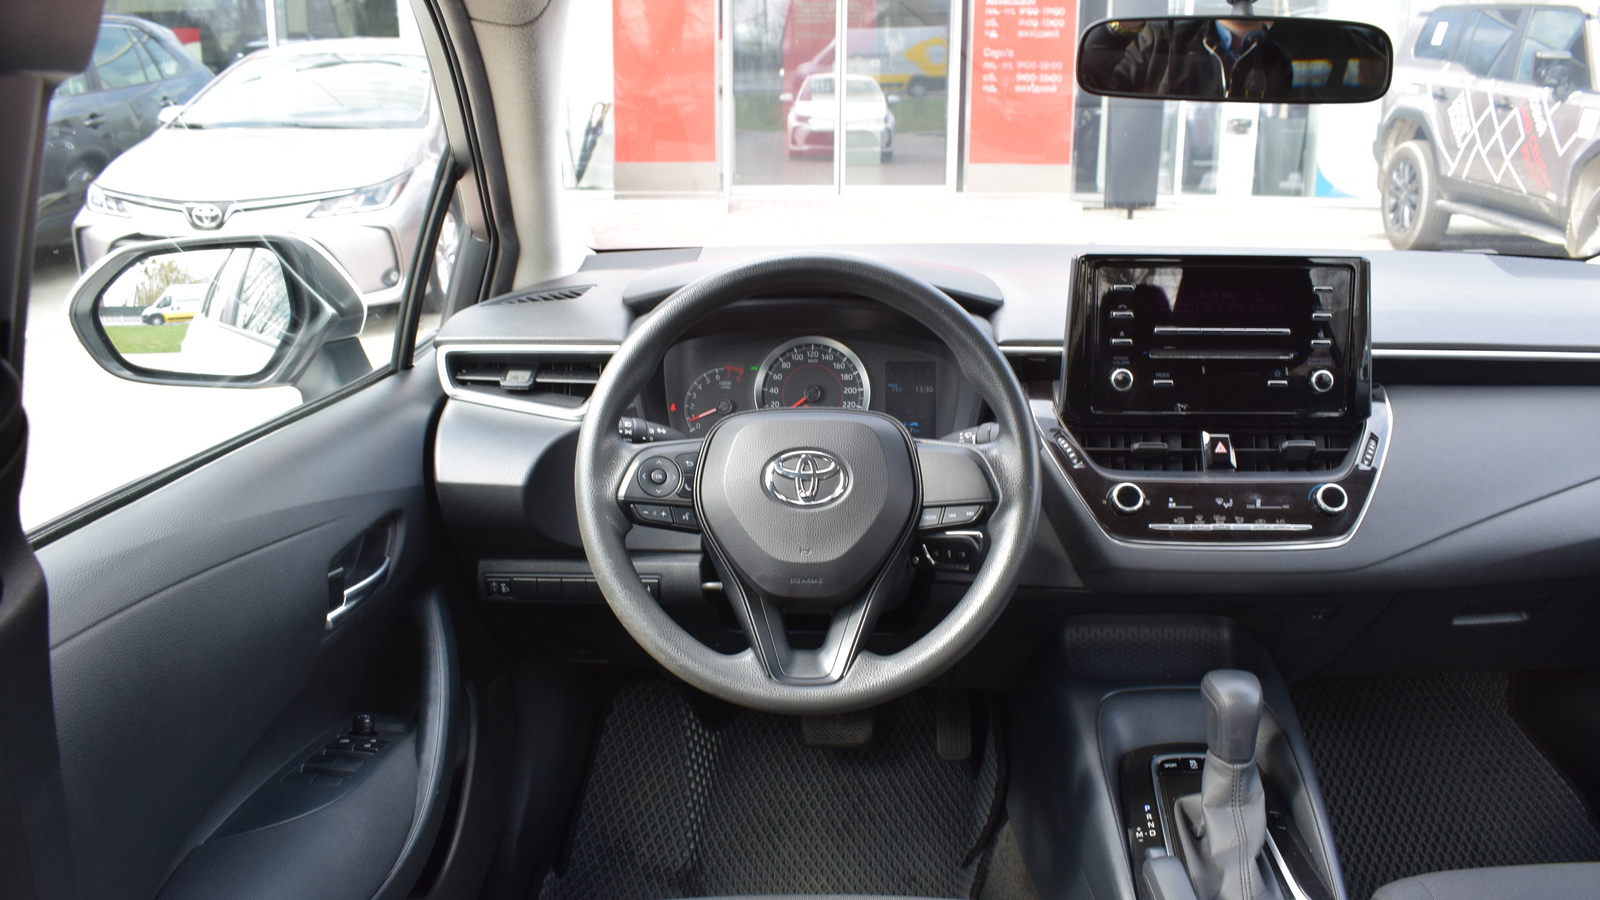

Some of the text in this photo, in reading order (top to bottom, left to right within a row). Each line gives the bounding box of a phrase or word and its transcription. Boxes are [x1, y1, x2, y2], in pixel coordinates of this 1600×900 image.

[833, 362, 846, 370] 160
[705, 376, 711, 384] 5
[715, 372, 721, 380] 6
[843, 387, 857, 395] 200
[690, 403, 695, 411] 2
[842, 401, 857, 409] 220
[1144, 804, 1151, 812] P
[1147, 821, 1155, 829] N
[1149, 829, 1156, 837] D
